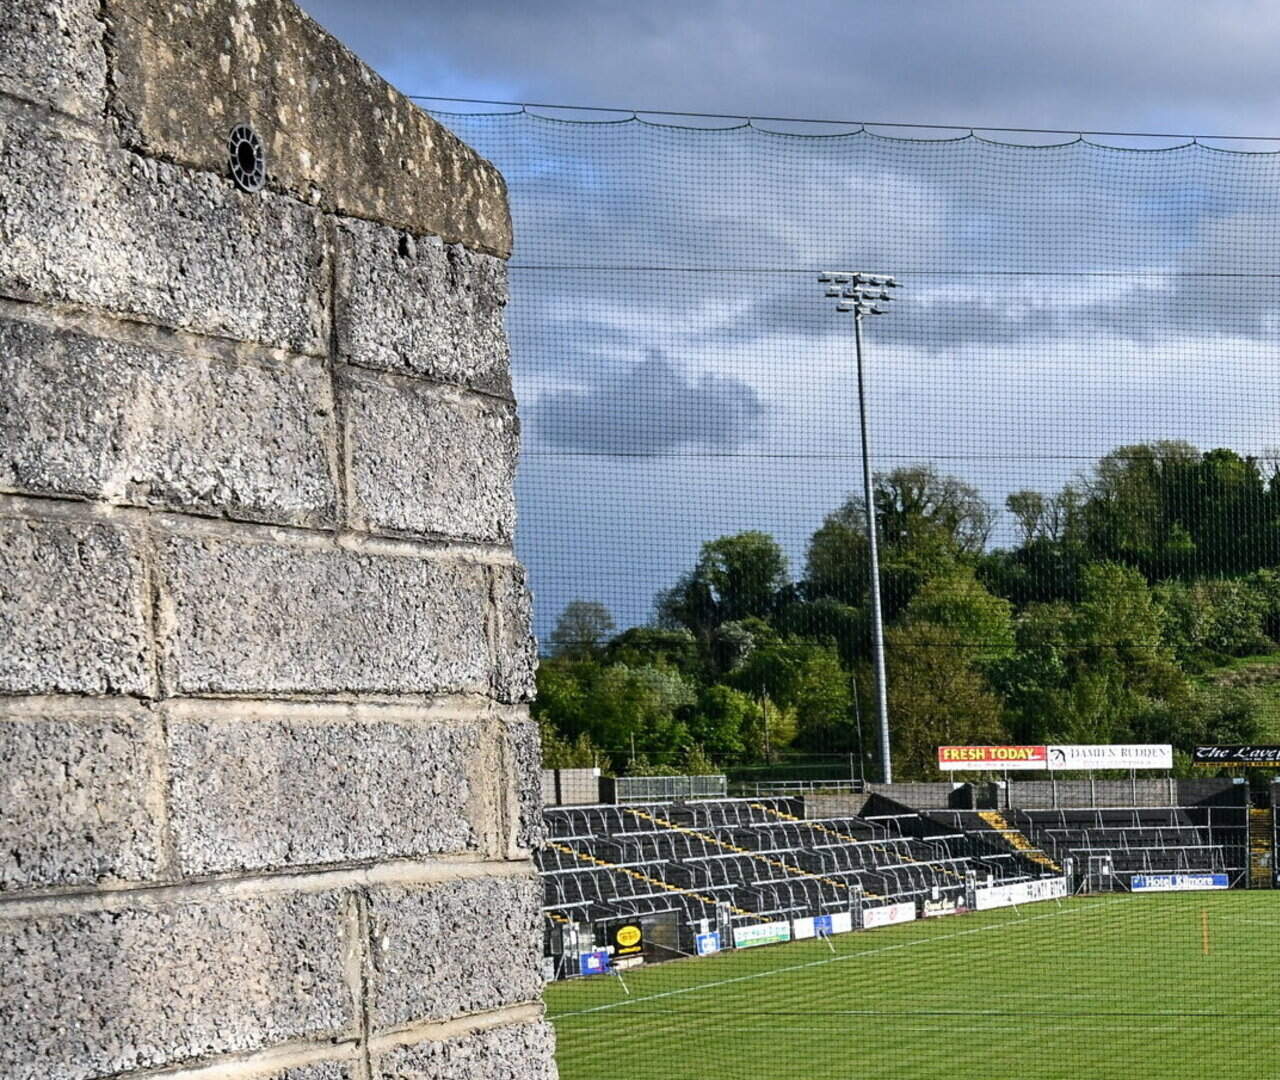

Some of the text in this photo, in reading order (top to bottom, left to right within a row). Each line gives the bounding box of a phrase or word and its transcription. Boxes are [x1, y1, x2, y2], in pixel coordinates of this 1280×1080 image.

[943, 748, 1034, 760] FRESH TODAY
[1196, 747, 1229, 758] The
[1146, 875, 1172, 887] Hotel
